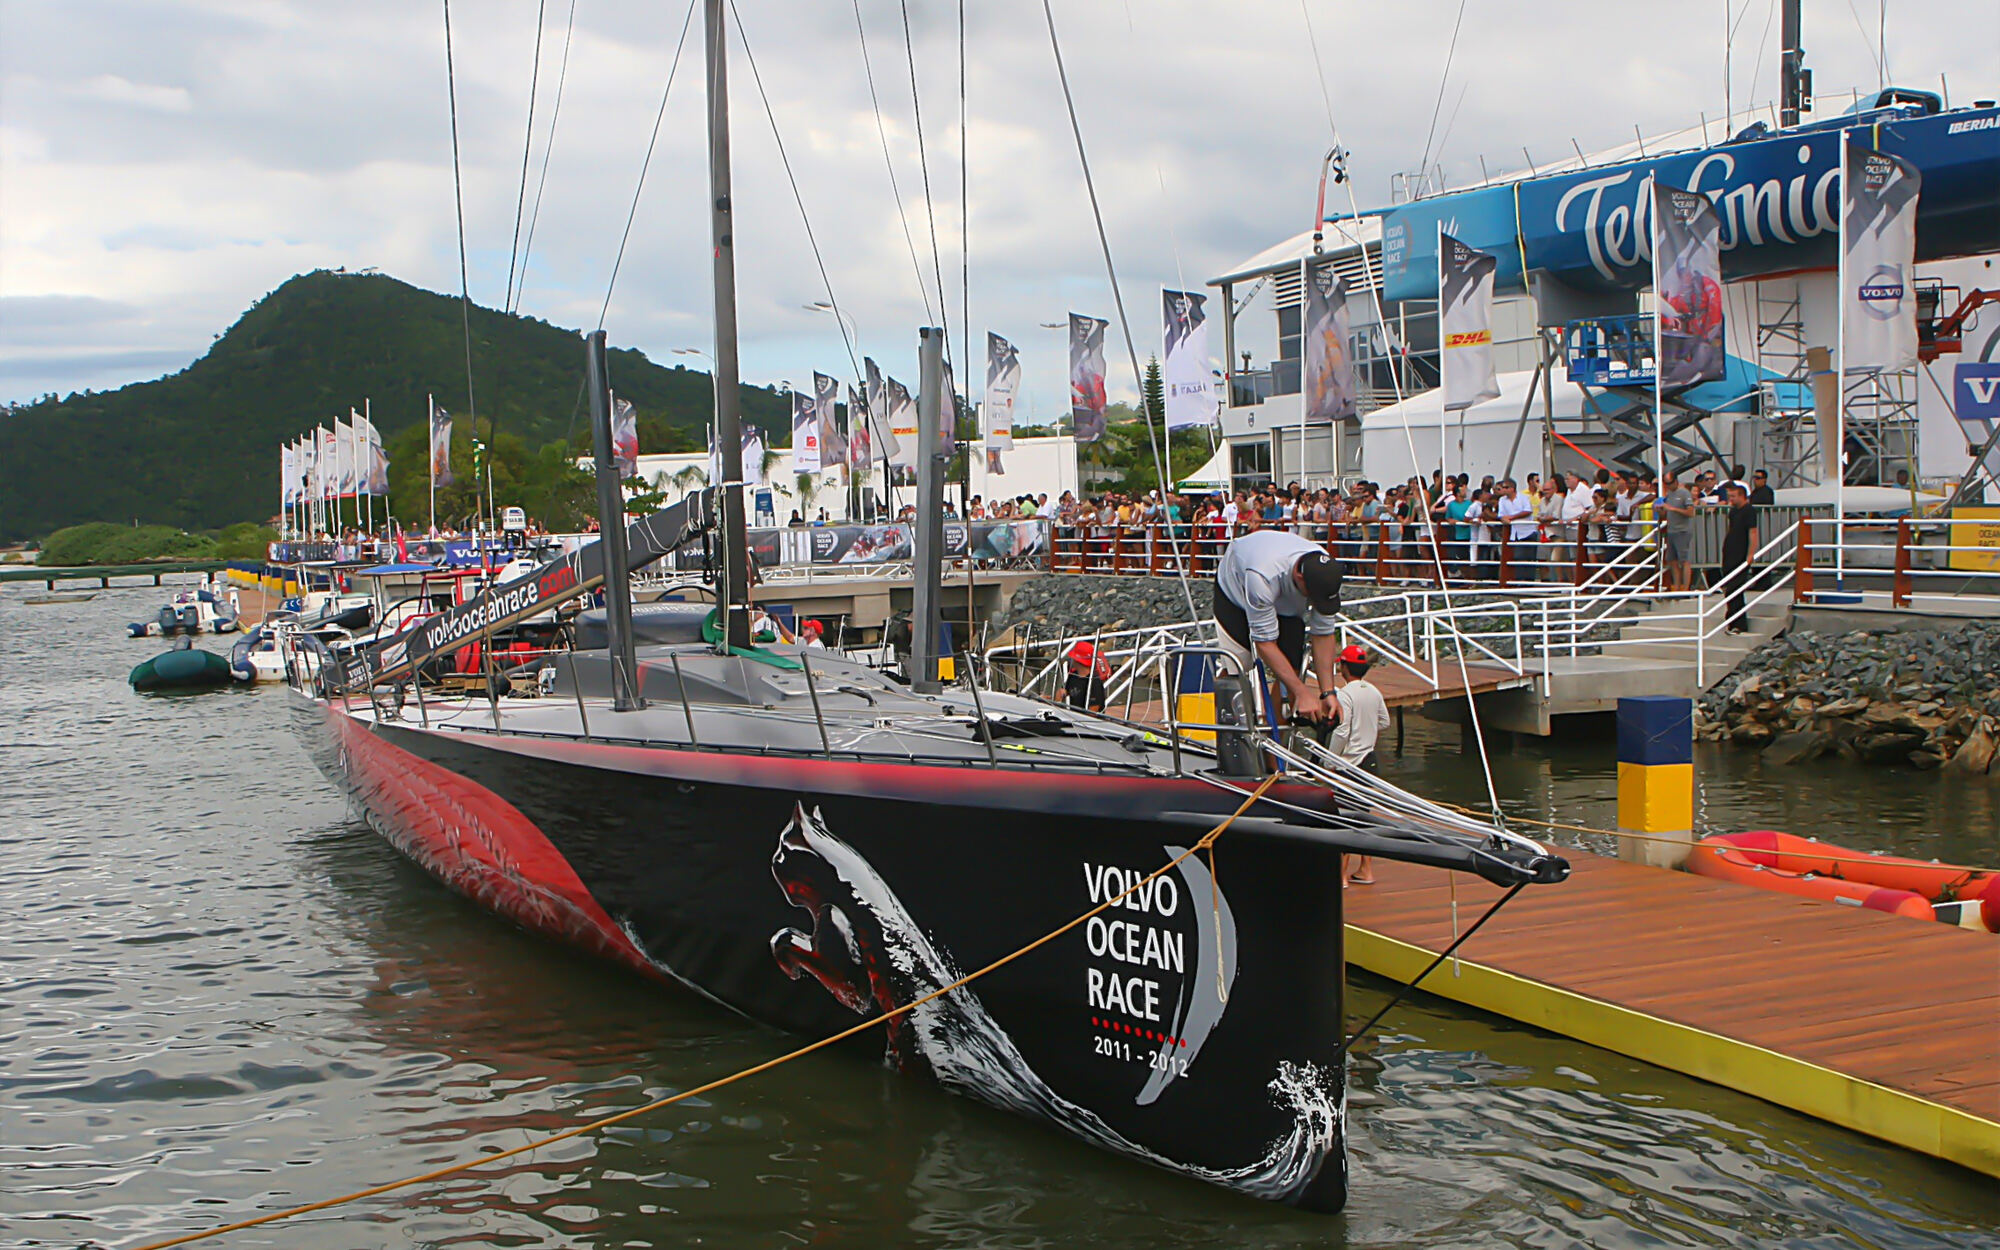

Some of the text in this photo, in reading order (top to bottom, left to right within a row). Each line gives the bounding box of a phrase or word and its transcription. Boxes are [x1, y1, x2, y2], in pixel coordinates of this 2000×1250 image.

[1865, 165, 1892, 174] OCEAN
[1386, 238, 1406, 253] OCEAN
[1862, 289, 1902, 297] VOLVO
[1452, 330, 1485, 345] DHL
[1083, 862, 1178, 917] VOLVO
[1086, 916, 1184, 974] OCEAN
[1088, 967, 1160, 1022] RACE
[1094, 1035, 1130, 1062] 2011
[1149, 1050, 1189, 1079] 2012
